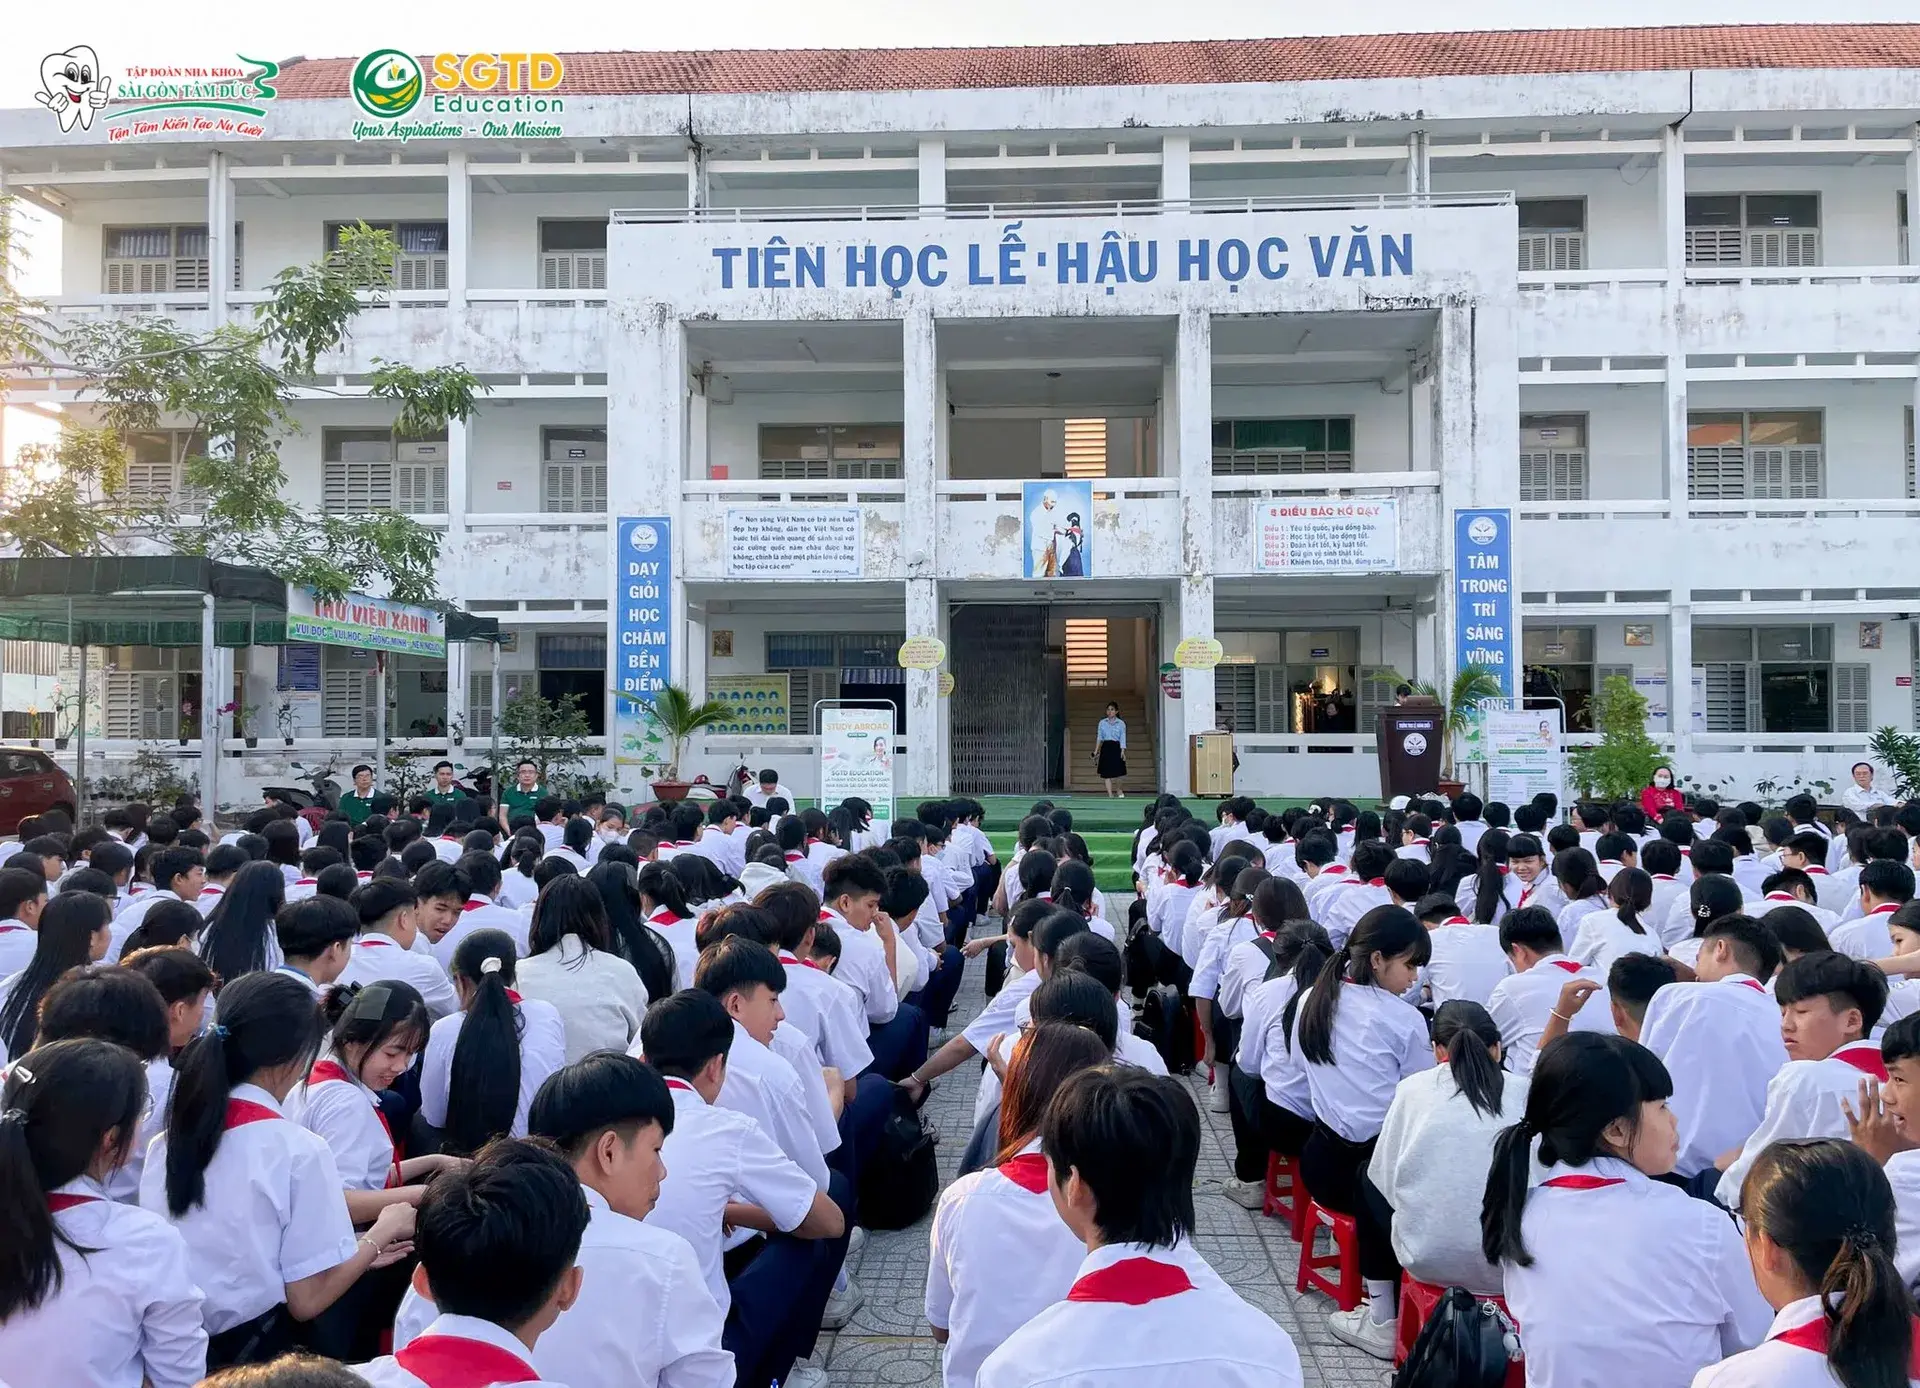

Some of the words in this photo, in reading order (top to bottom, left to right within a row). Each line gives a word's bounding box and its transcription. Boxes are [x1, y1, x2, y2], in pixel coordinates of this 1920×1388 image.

[712, 236, 825, 289] TIÊN
[846, 244, 948, 299] HỌC
[968, 220, 1026, 286] LỄ
[1057, 230, 1158, 296] HẬU
[1178, 236, 1289, 294] HỌC
[1309, 225, 1413, 278] VĂN
[1468, 552, 1499, 569] TÂM
[629, 562, 660, 578] DẠY
[629, 580, 659, 600] GIỎI
[1460, 579, 1508, 594] TRONG
[629, 608, 660, 624] HỌC
[1472, 600, 1496, 617] TRÍ
[296, 624, 309, 633] VUI
[311, 626, 327, 637] ĐỌC
[392, 611, 429, 634] XANH
[622, 629, 666, 645] CHĂM
[1466, 623, 1504, 641] SÁNG
[628, 649, 660, 669] BỀN
[1466, 648, 1504, 664] VỮNG
[624, 671, 663, 692] ĐIỂM
